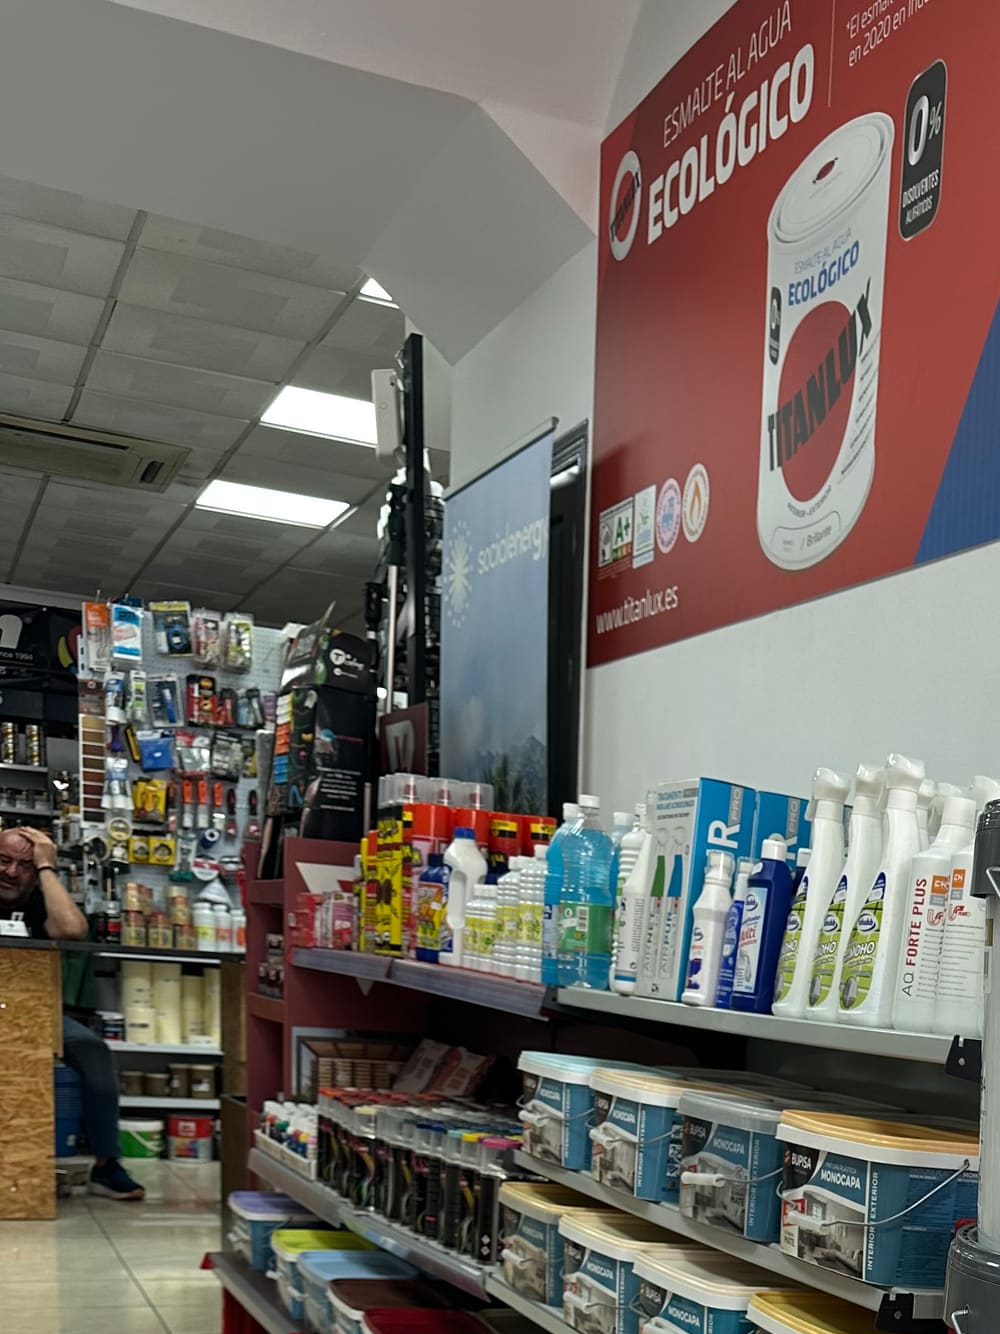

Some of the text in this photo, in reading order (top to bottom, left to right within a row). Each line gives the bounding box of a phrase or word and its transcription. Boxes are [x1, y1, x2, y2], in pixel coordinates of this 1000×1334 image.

[849, 7, 906, 67] en 2020 en
[664, 0, 791, 147] ESMALTE AL AGUA
[648, 43, 814, 245] ECOLÓGICO
[788, 240, 860, 306] ECOLÓGICO
[767, 276, 873, 472] TITANLUX
[912, 878, 927, 916] PLUS
[906, 920, 922, 967] FORTE
[791, 1152, 812, 1170] BUPISA
[821, 1169, 861, 1190] MONOCAPA
[867, 1171, 880, 1271] INTERIOR EXTERIOR
[668, 1305, 701, 1328] MONOCAPA
